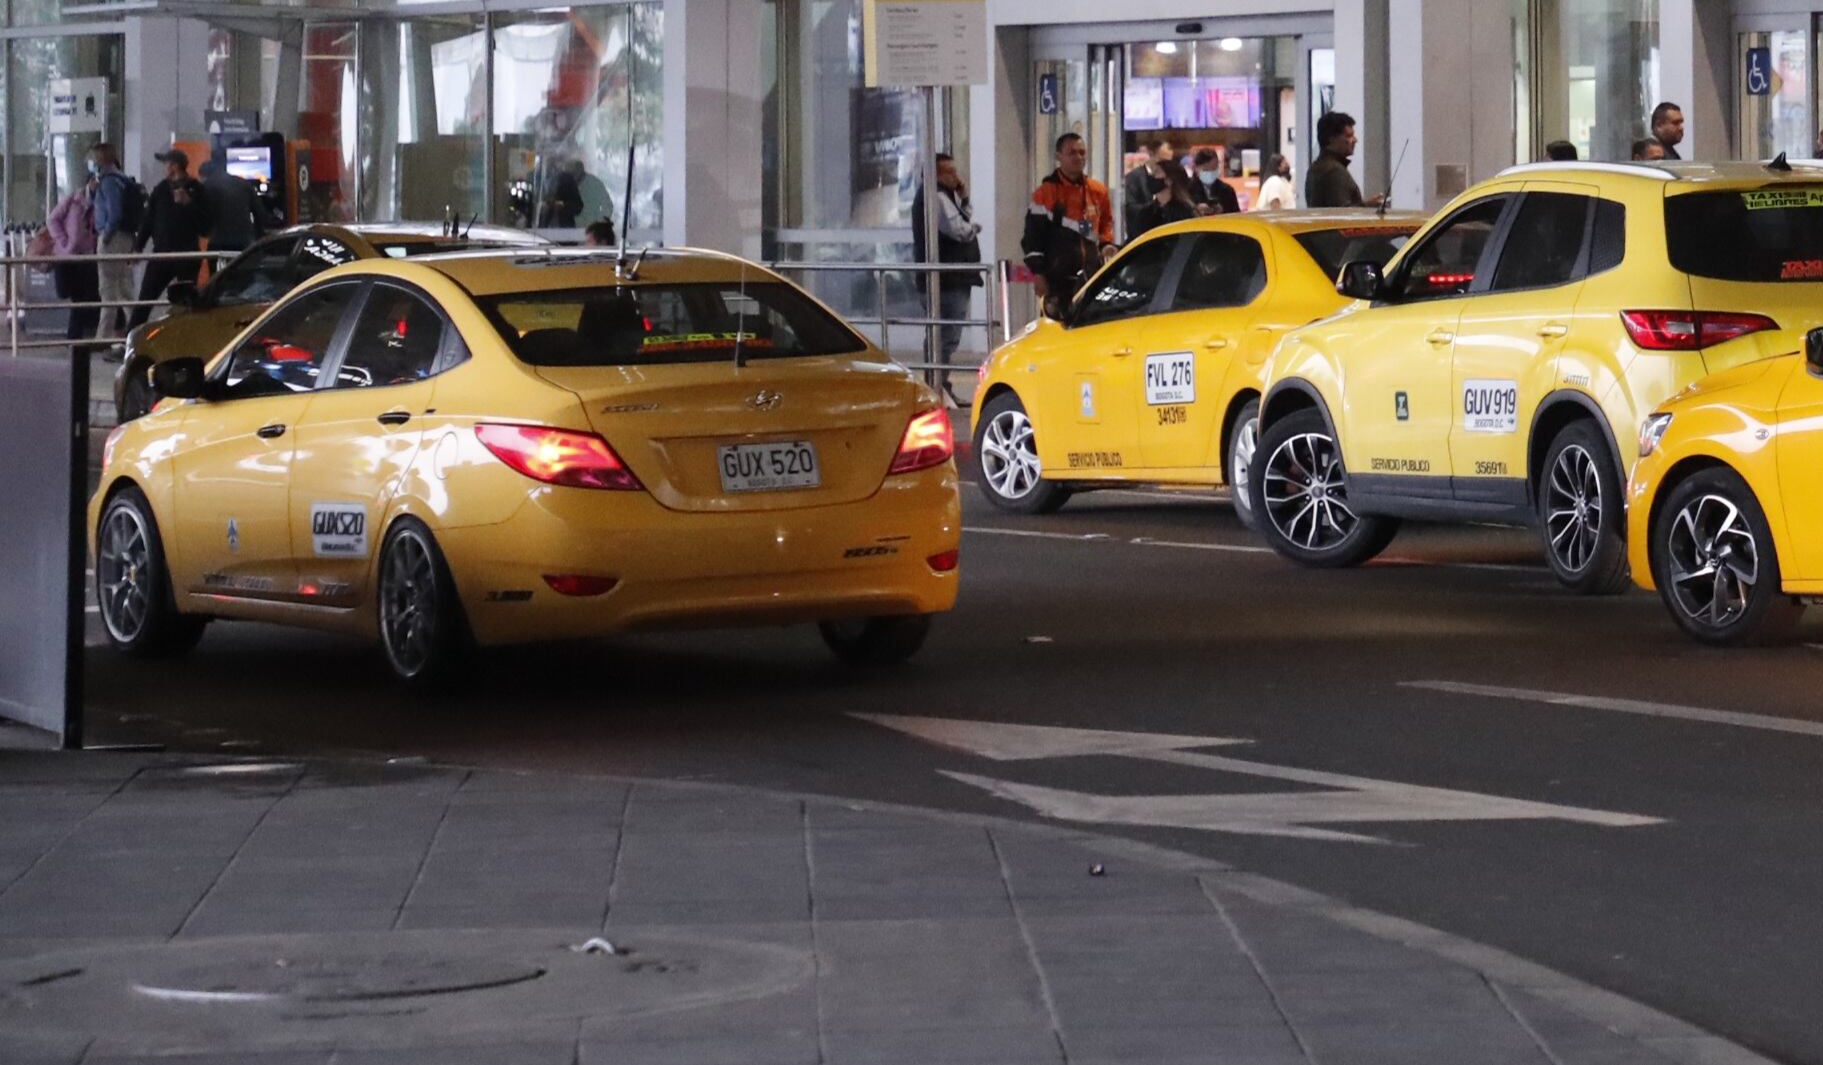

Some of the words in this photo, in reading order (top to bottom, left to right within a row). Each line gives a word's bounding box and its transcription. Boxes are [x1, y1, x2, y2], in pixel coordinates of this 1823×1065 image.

[1147, 362, 1168, 388] FVL
[1171, 360, 1192, 386] 276
[723, 451, 766, 479] GUX
[770, 448, 814, 476] 520
[1371, 457, 1400, 471] SERVICIO
[1401, 458, 1430, 472] PUBLICO
